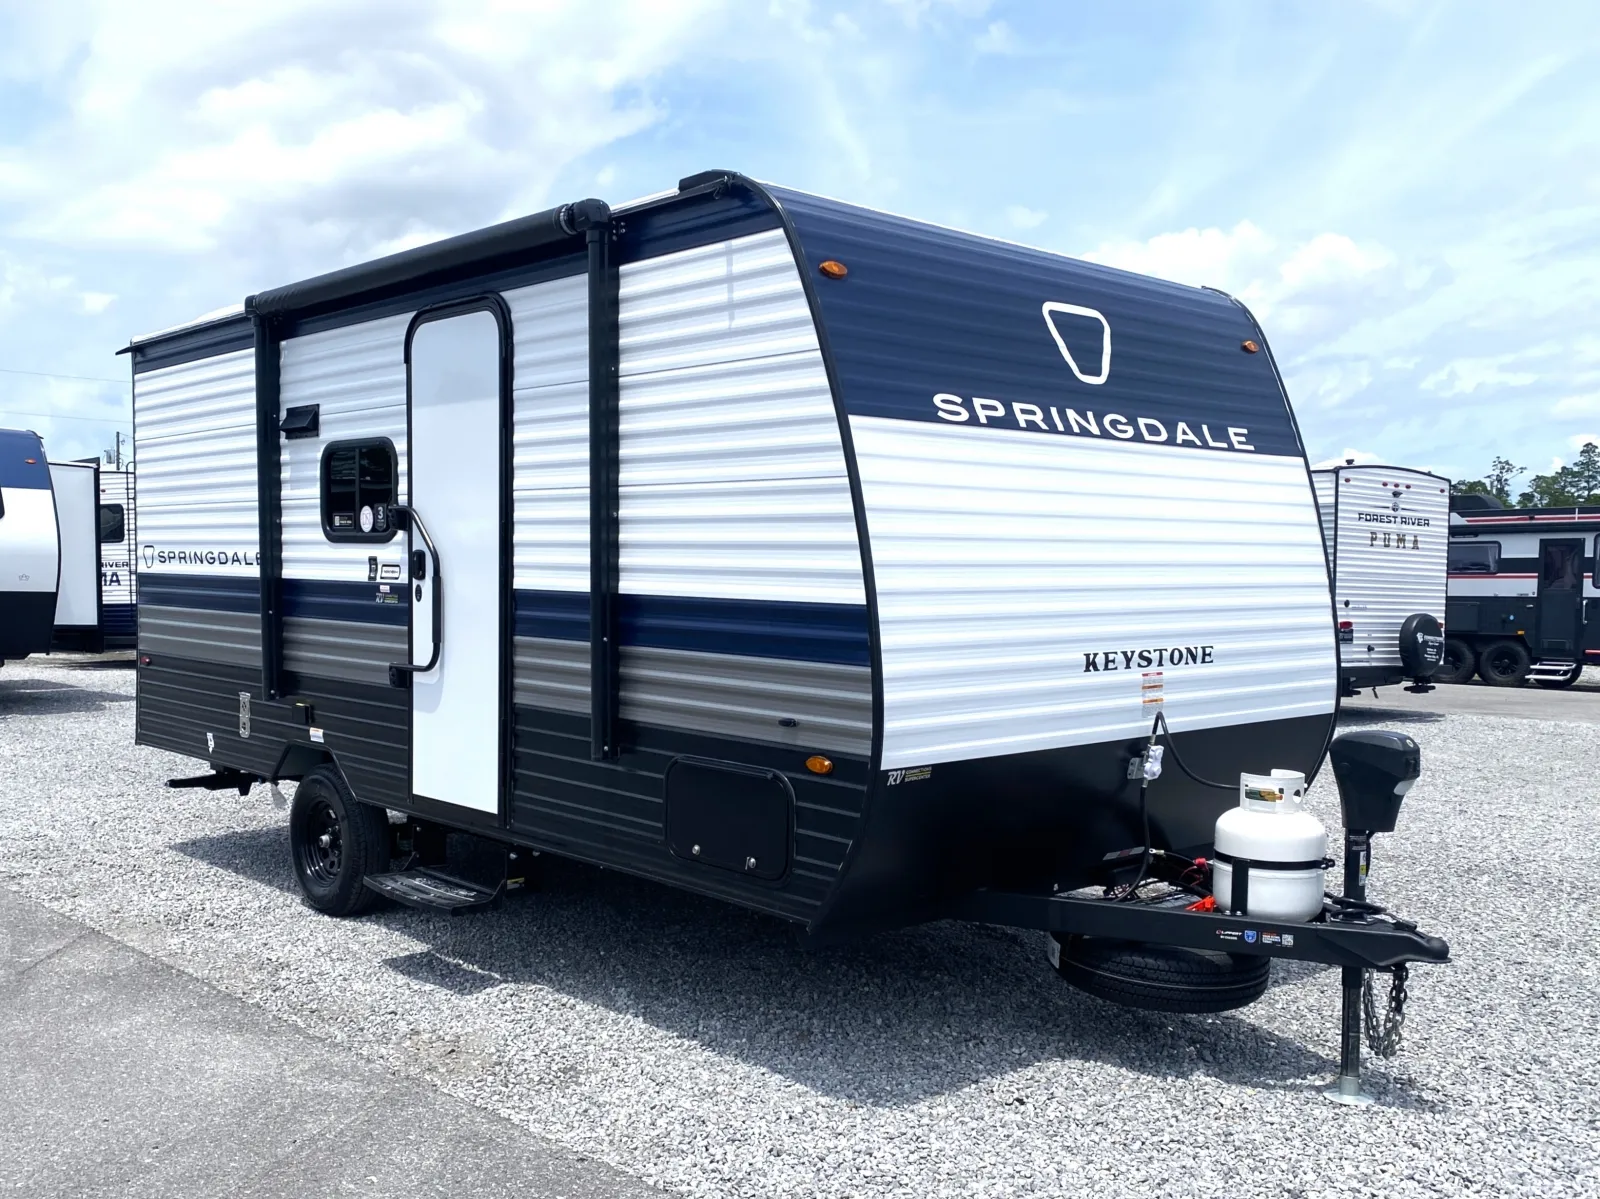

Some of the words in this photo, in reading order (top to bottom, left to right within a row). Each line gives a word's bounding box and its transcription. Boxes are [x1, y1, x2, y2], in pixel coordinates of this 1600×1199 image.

[932, 393, 1255, 451] SPRINGDALE
[377, 506, 384, 519] 3
[1357, 512, 1398, 524] FOREST
[1400, 516, 1430, 527] RIVER
[1370, 531, 1419, 550] PUMA
[1083, 645, 1214, 672] KEYSTONE
[886, 769, 905, 786] RV
